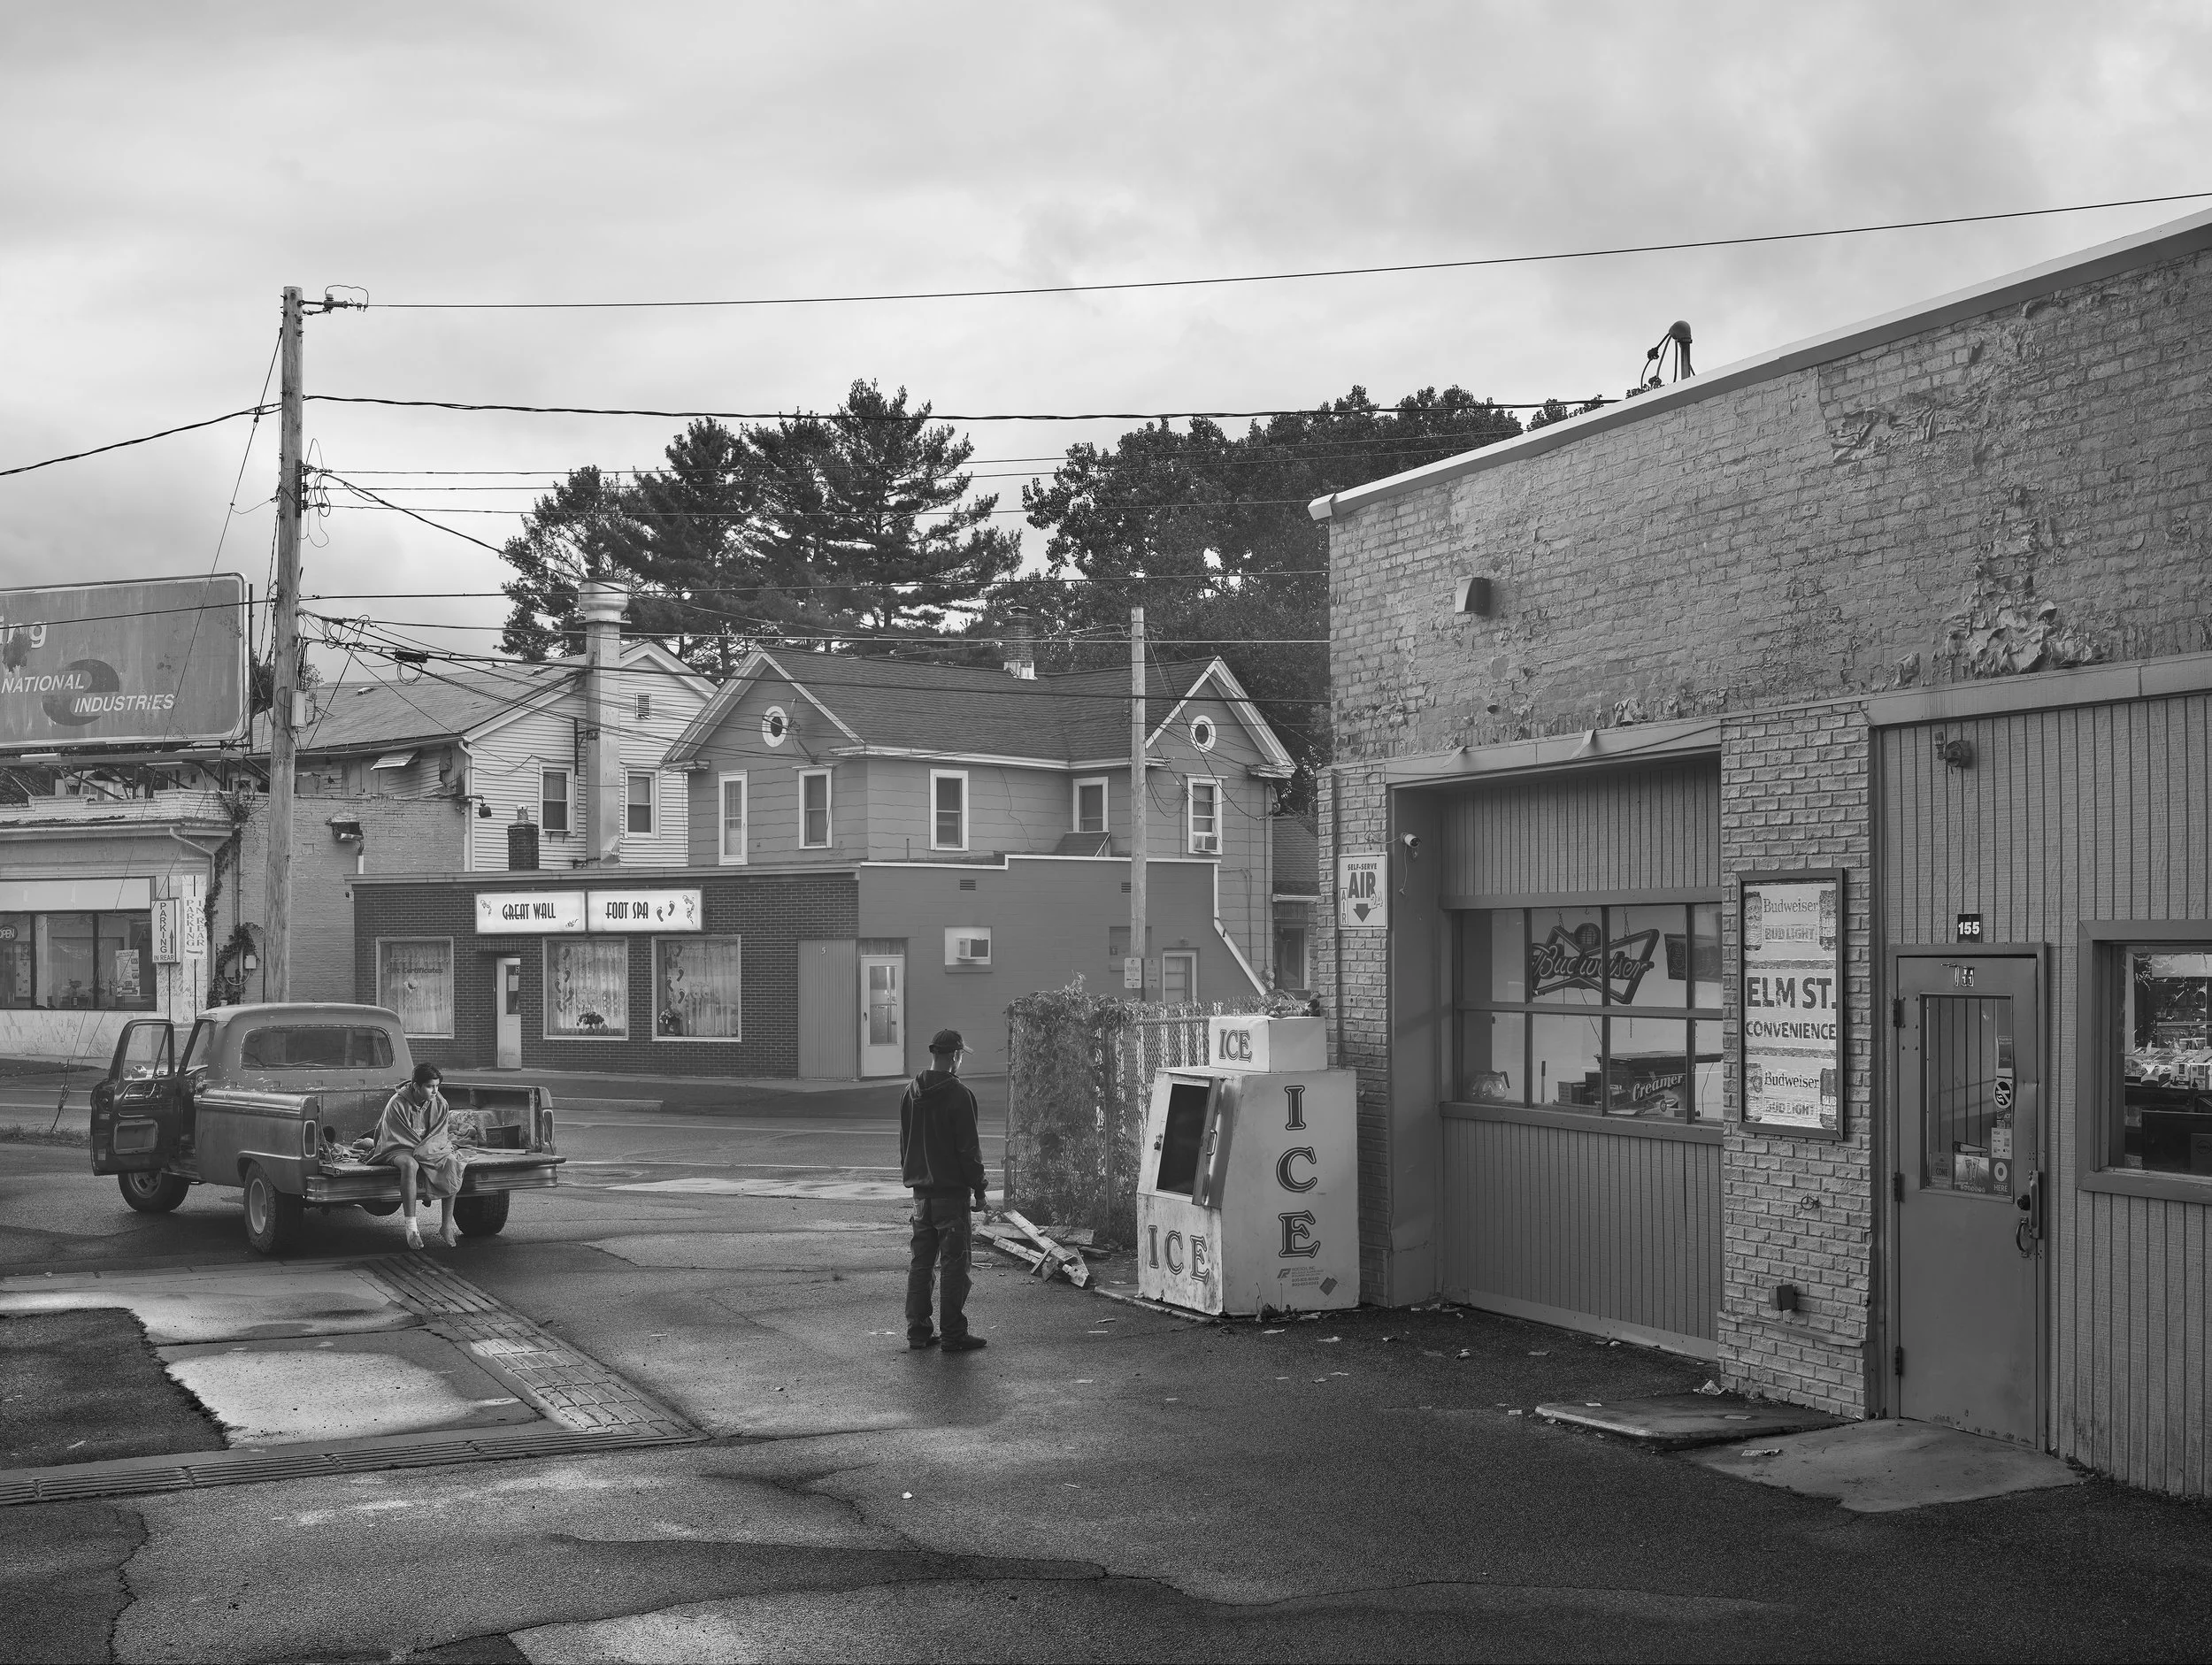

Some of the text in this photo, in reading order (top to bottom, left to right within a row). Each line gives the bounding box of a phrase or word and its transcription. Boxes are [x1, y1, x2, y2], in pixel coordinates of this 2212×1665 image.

[1, 674, 85, 694] NATIONAL
[74, 694, 175, 713] INDUSTRIES
[1348, 871, 1376, 898] AIR
[503, 902, 649, 920] GREAT WALL FOOT SPA
[1763, 899, 1818, 913] Budweiser
[1786, 927, 1815, 940] LIGHT
[1958, 921, 1979, 934] 155
[1747, 977, 1836, 1009] ELM ST.
[1746, 1020, 1836, 1040] CONVENIENCE
[1219, 1029, 1253, 1063] ICE
[1632, 1075, 1683, 1101] Creamer
[1764, 1071, 1820, 1089] Budweiser
[1276, 1085, 1321, 1259] ICE
[1148, 1224, 1210, 1284] ICE
